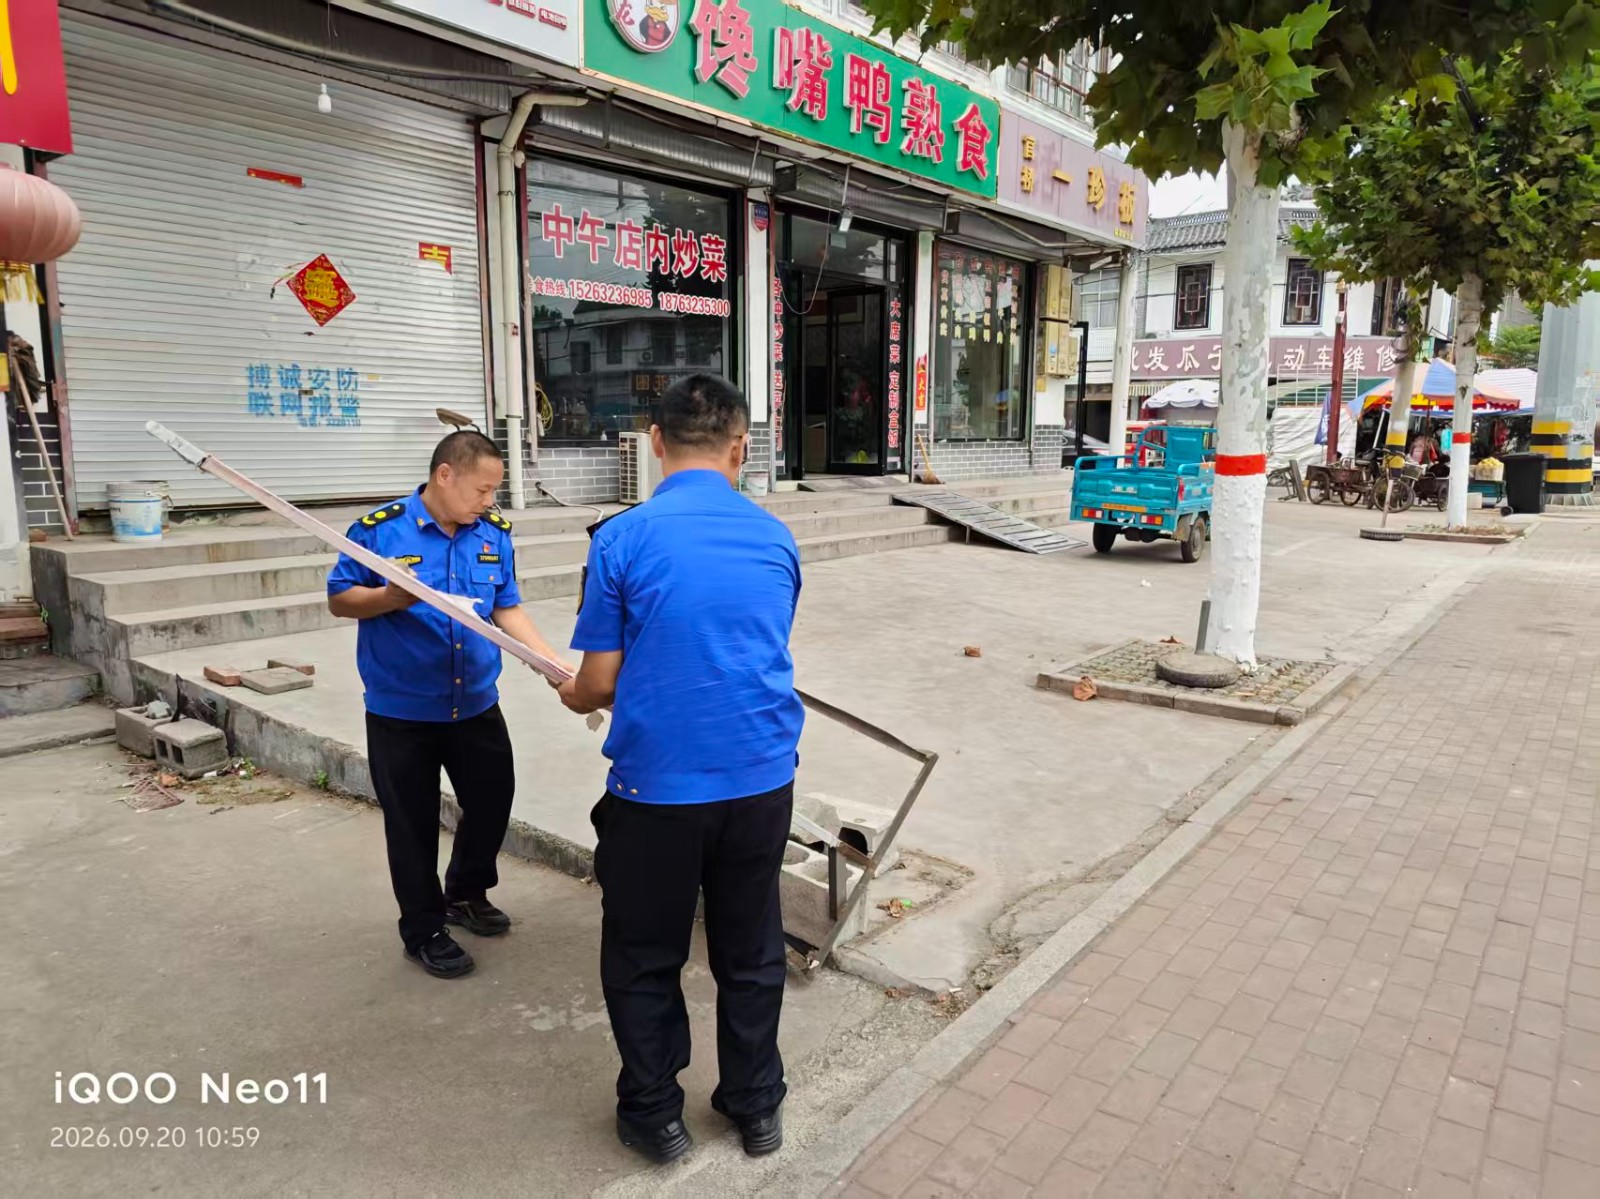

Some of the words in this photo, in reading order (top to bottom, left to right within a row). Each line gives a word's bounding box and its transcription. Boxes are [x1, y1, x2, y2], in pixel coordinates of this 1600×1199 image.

[689, 0, 991, 180] 馋嘴鸭熟食
[541, 203, 727, 283] 中午店内炒菜
[657, 291, 731, 317] 18763235300
[1268, 345, 1398, 373] 动车维修
